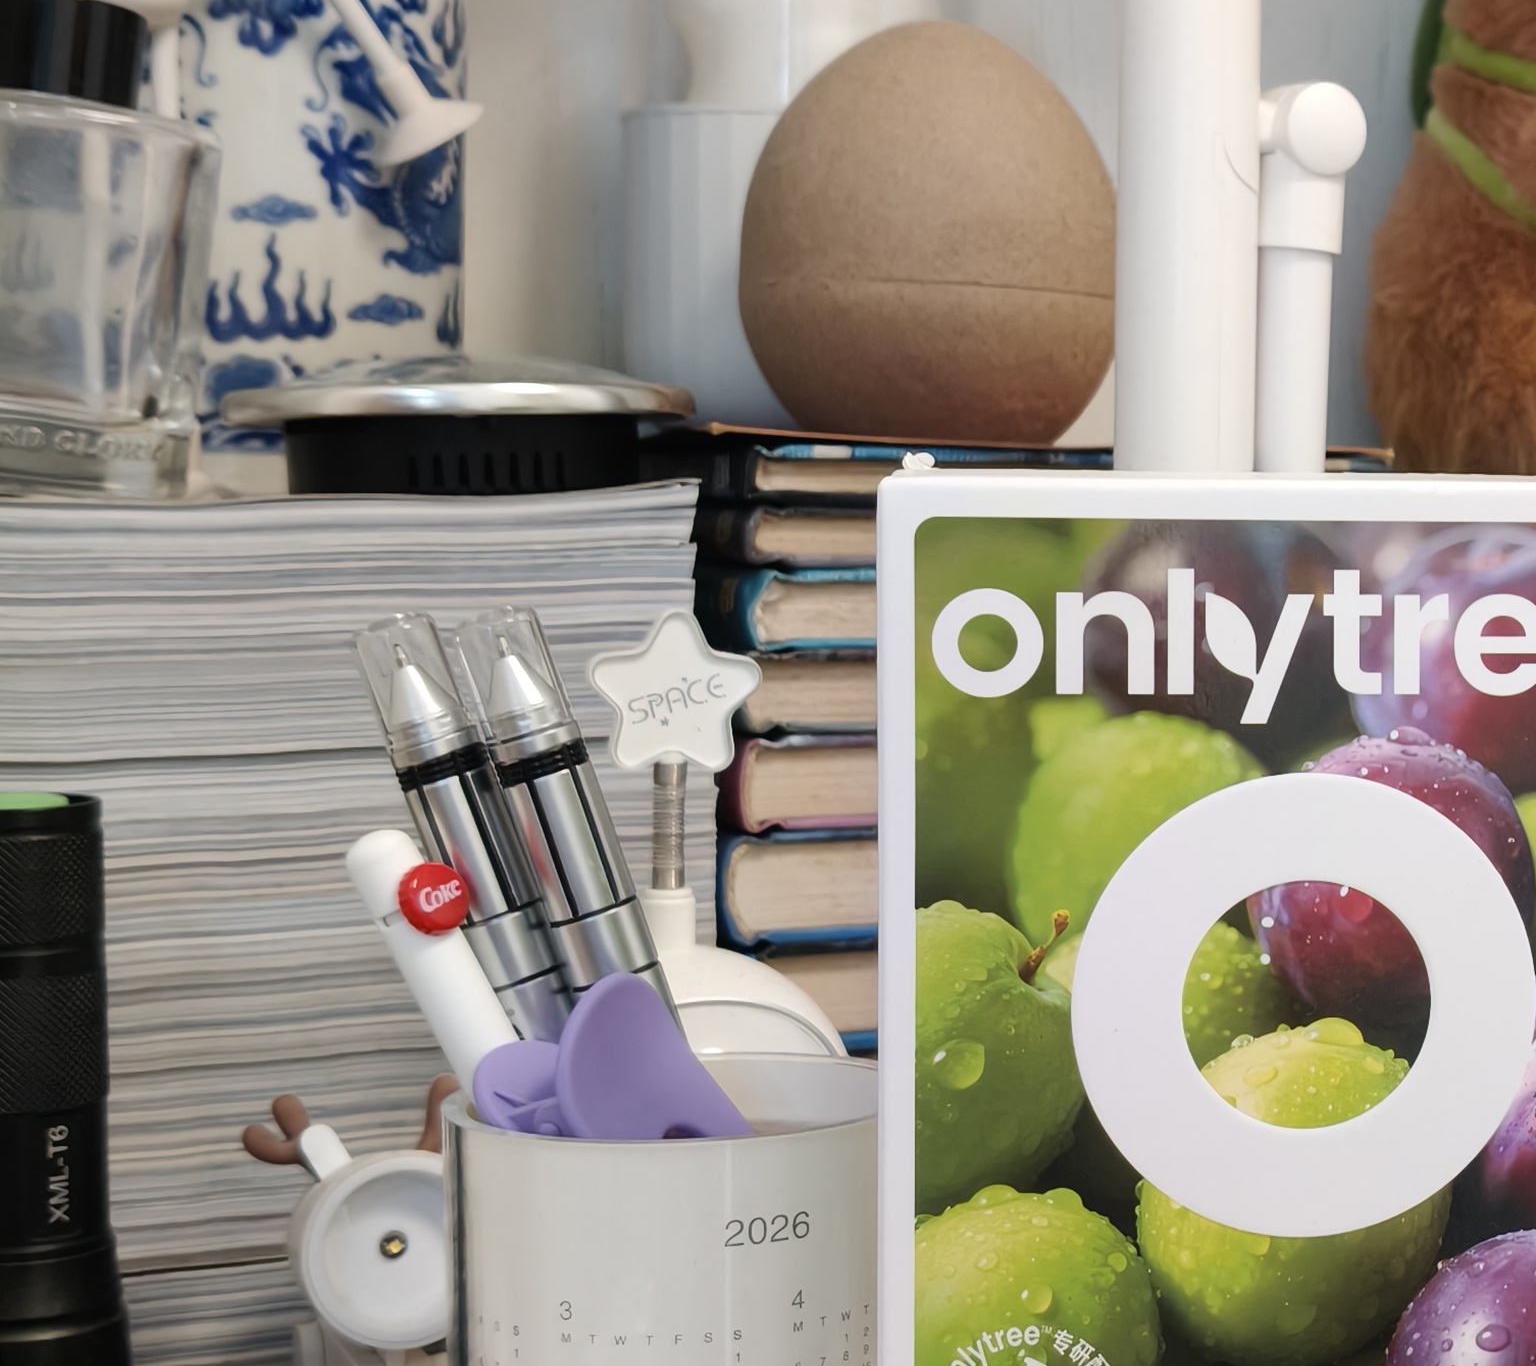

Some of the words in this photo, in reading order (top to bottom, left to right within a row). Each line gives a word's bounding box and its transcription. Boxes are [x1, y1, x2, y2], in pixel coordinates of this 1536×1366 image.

[628, 673, 727, 725] SPACE
[419, 879, 462, 913] Coke
[47, 1125, 70, 1224] XML-T6
[724, 1211, 810, 1247] 2026
[560, 1301, 573, 1321] 3
[561, 1333, 572, 1343] M
[589, 1334, 597, 1345] T
[615, 1336, 627, 1346] W
[647, 1336, 654, 1346] T
[675, 1335, 683, 1345] F
[705, 1332, 713, 1344] S
[734, 1330, 743, 1341] S
[735, 1353, 741, 1363] 1
